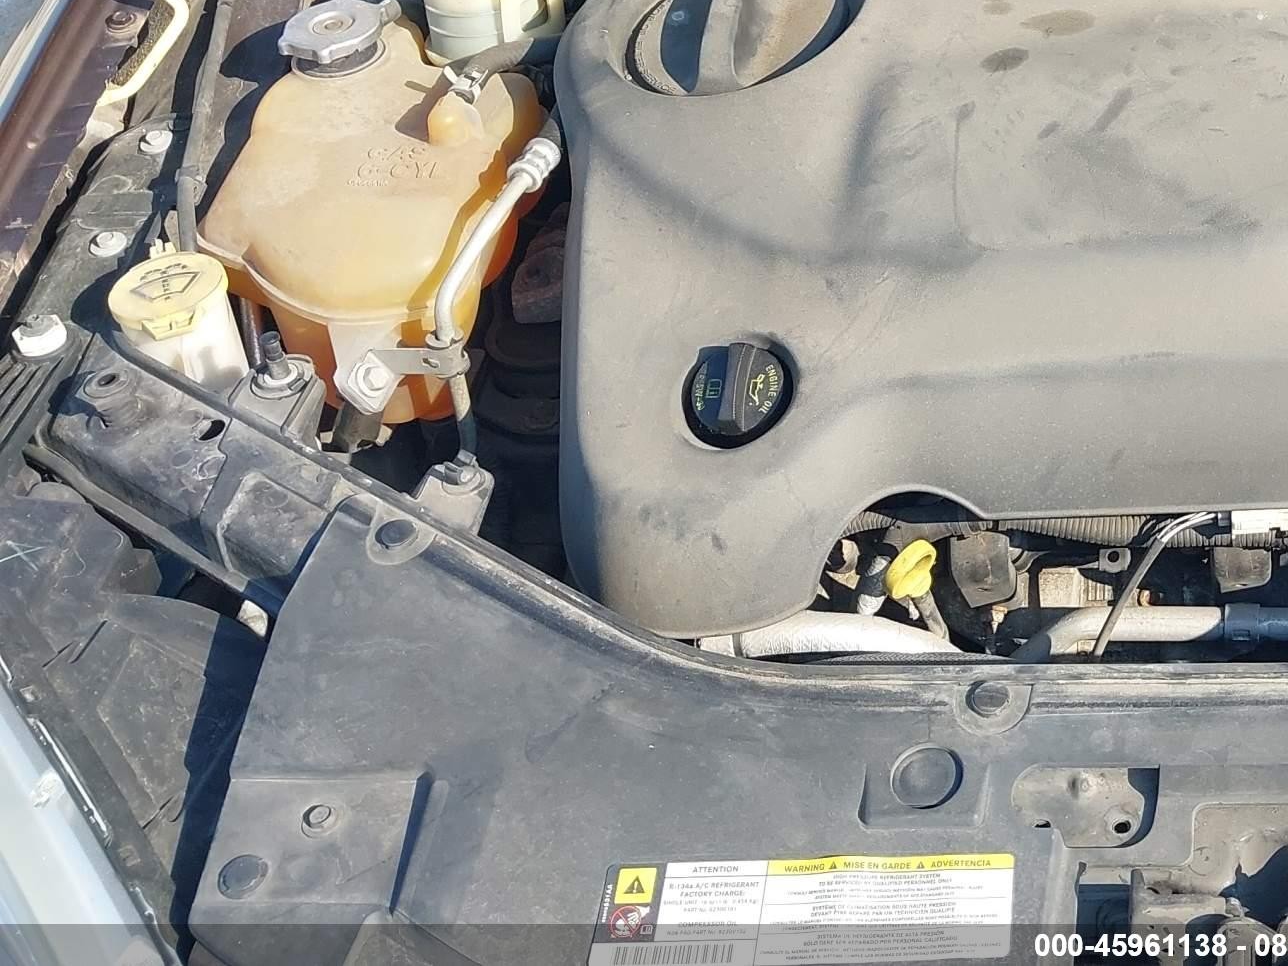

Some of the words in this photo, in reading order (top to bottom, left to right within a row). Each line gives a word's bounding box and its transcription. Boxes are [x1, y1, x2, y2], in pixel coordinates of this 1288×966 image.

[765, 364, 779, 397] ENGINE
[758, 400, 772, 414] OIL
[785, 863, 825, 873] WARNING
[843, 861, 865, 869] MISE
[882, 862, 911, 870] GARDE
[930, 859, 991, 868] ADVERTENCIA
